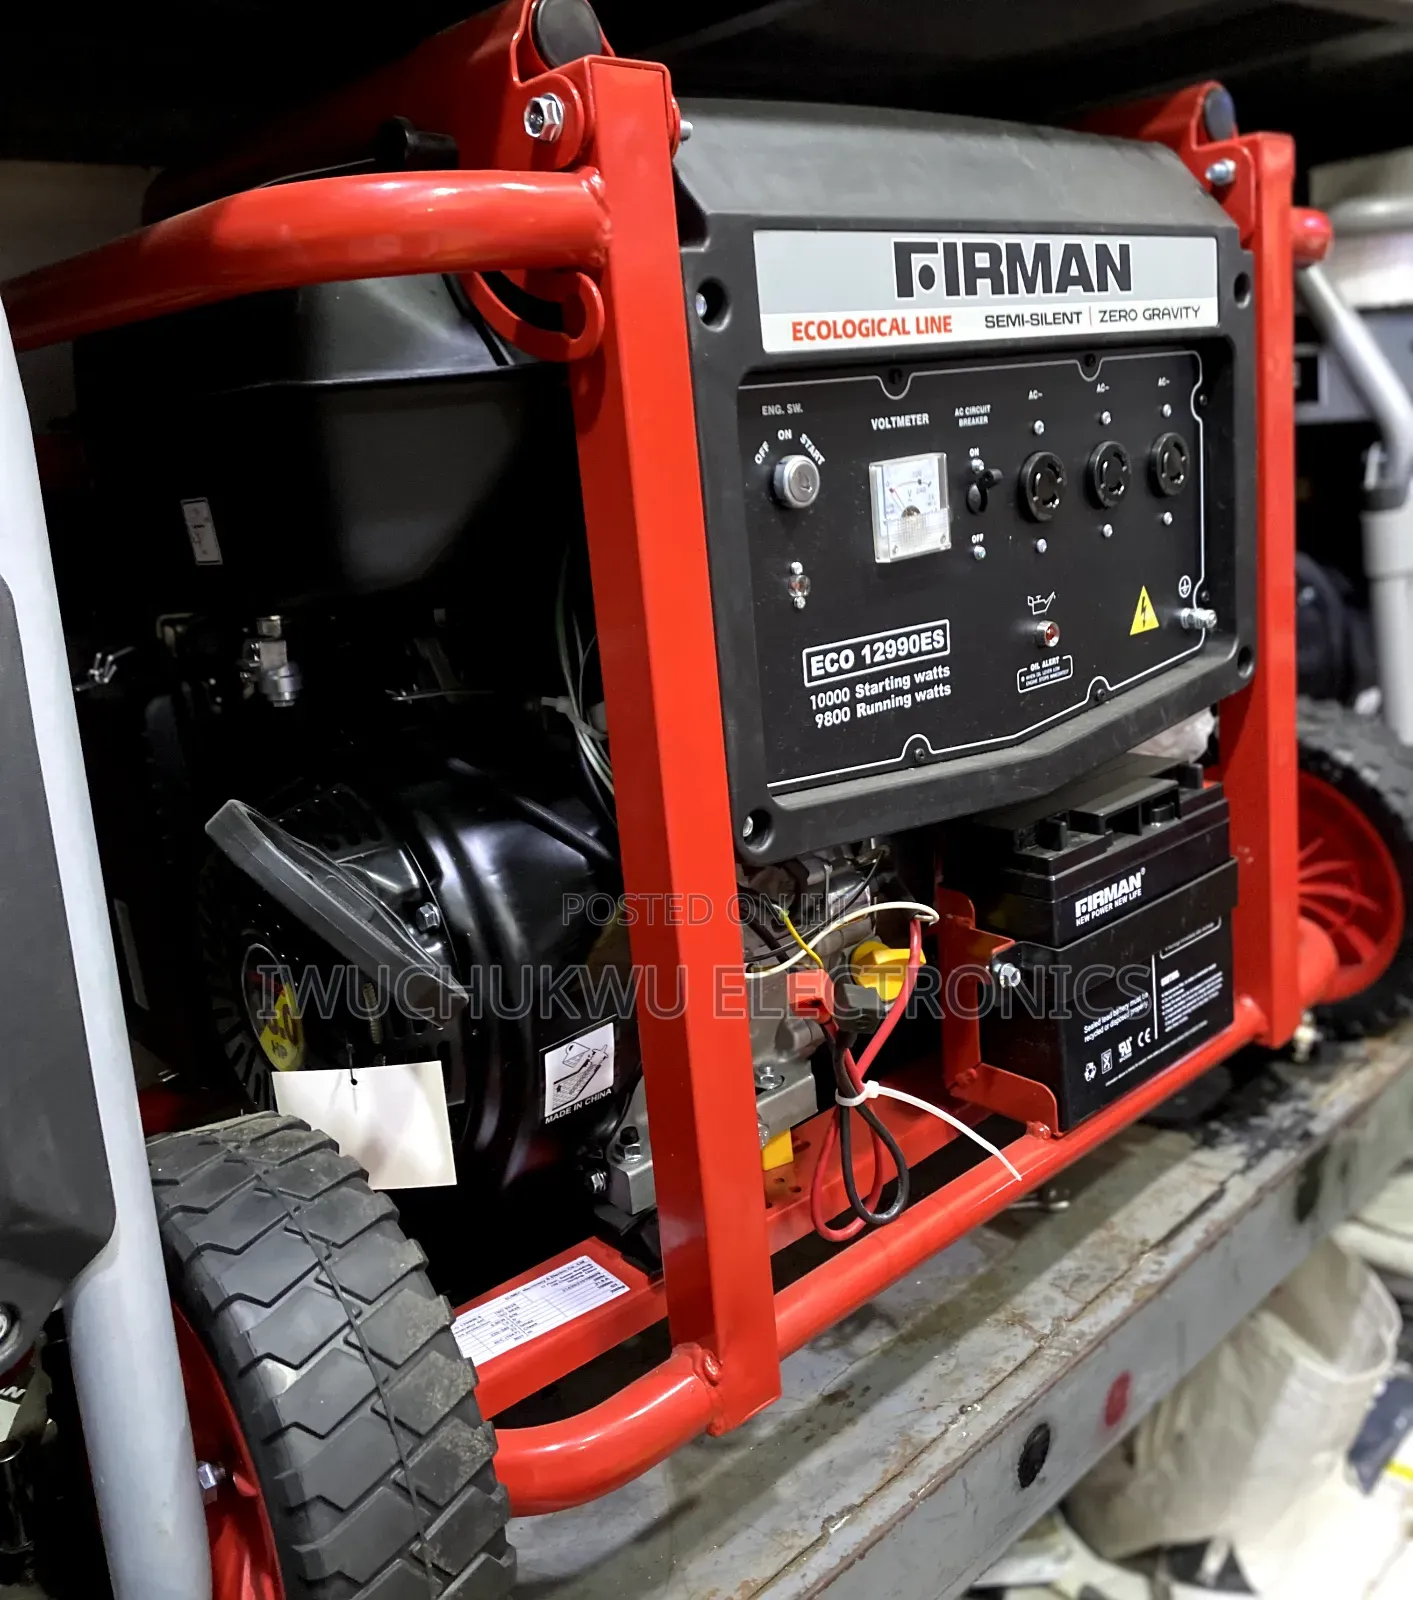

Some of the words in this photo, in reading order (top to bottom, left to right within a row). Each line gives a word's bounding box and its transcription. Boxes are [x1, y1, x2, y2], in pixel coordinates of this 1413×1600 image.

[893, 238, 1132, 299] FIRMAN
[984, 311, 1082, 328] SEMI-SILENT
[1098, 308, 1138, 323] ZERO
[1142, 304, 1201, 321] GRAVITY
[792, 317, 910, 341] ECOLOGICAL
[915, 314, 952, 336] LINE
[762, 405, 785, 416] ENG.
[787, 403, 803, 414] SW.
[954, 406, 964, 417] AC
[965, 404, 991, 416] CIRCUIT
[871, 413, 930, 430] VOLTMETER
[958, 415, 989, 427] BREAKER
[755, 441, 770, 465] OFF
[778, 429, 792, 440] ON
[799, 434, 826, 465] START
[969, 448, 980, 457] ON
[971, 533, 984, 544] OFF
[810, 648, 855, 677] ECO
[861, 629, 945, 665] 12990ES
[1030, 662, 1040, 671] OIL
[1042, 656, 1060, 668] ALERT
[809, 687, 850, 710] 10000
[855, 674, 911, 699] Starting
[913, 664, 951, 684] watts
[815, 706, 850, 729] 9800
[856, 692, 912, 718] Running
[914, 682, 952, 703] watts
[1075, 913, 1090, 926] NEW
[1091, 903, 1113, 919] POWER
[1114, 895, 1128, 908] NEW
[1129, 888, 1142, 900] LIFE
[545, 1106, 571, 1124] MADE
[573, 1103, 582, 1111] IN
[585, 1088, 612, 1105] CHINA
